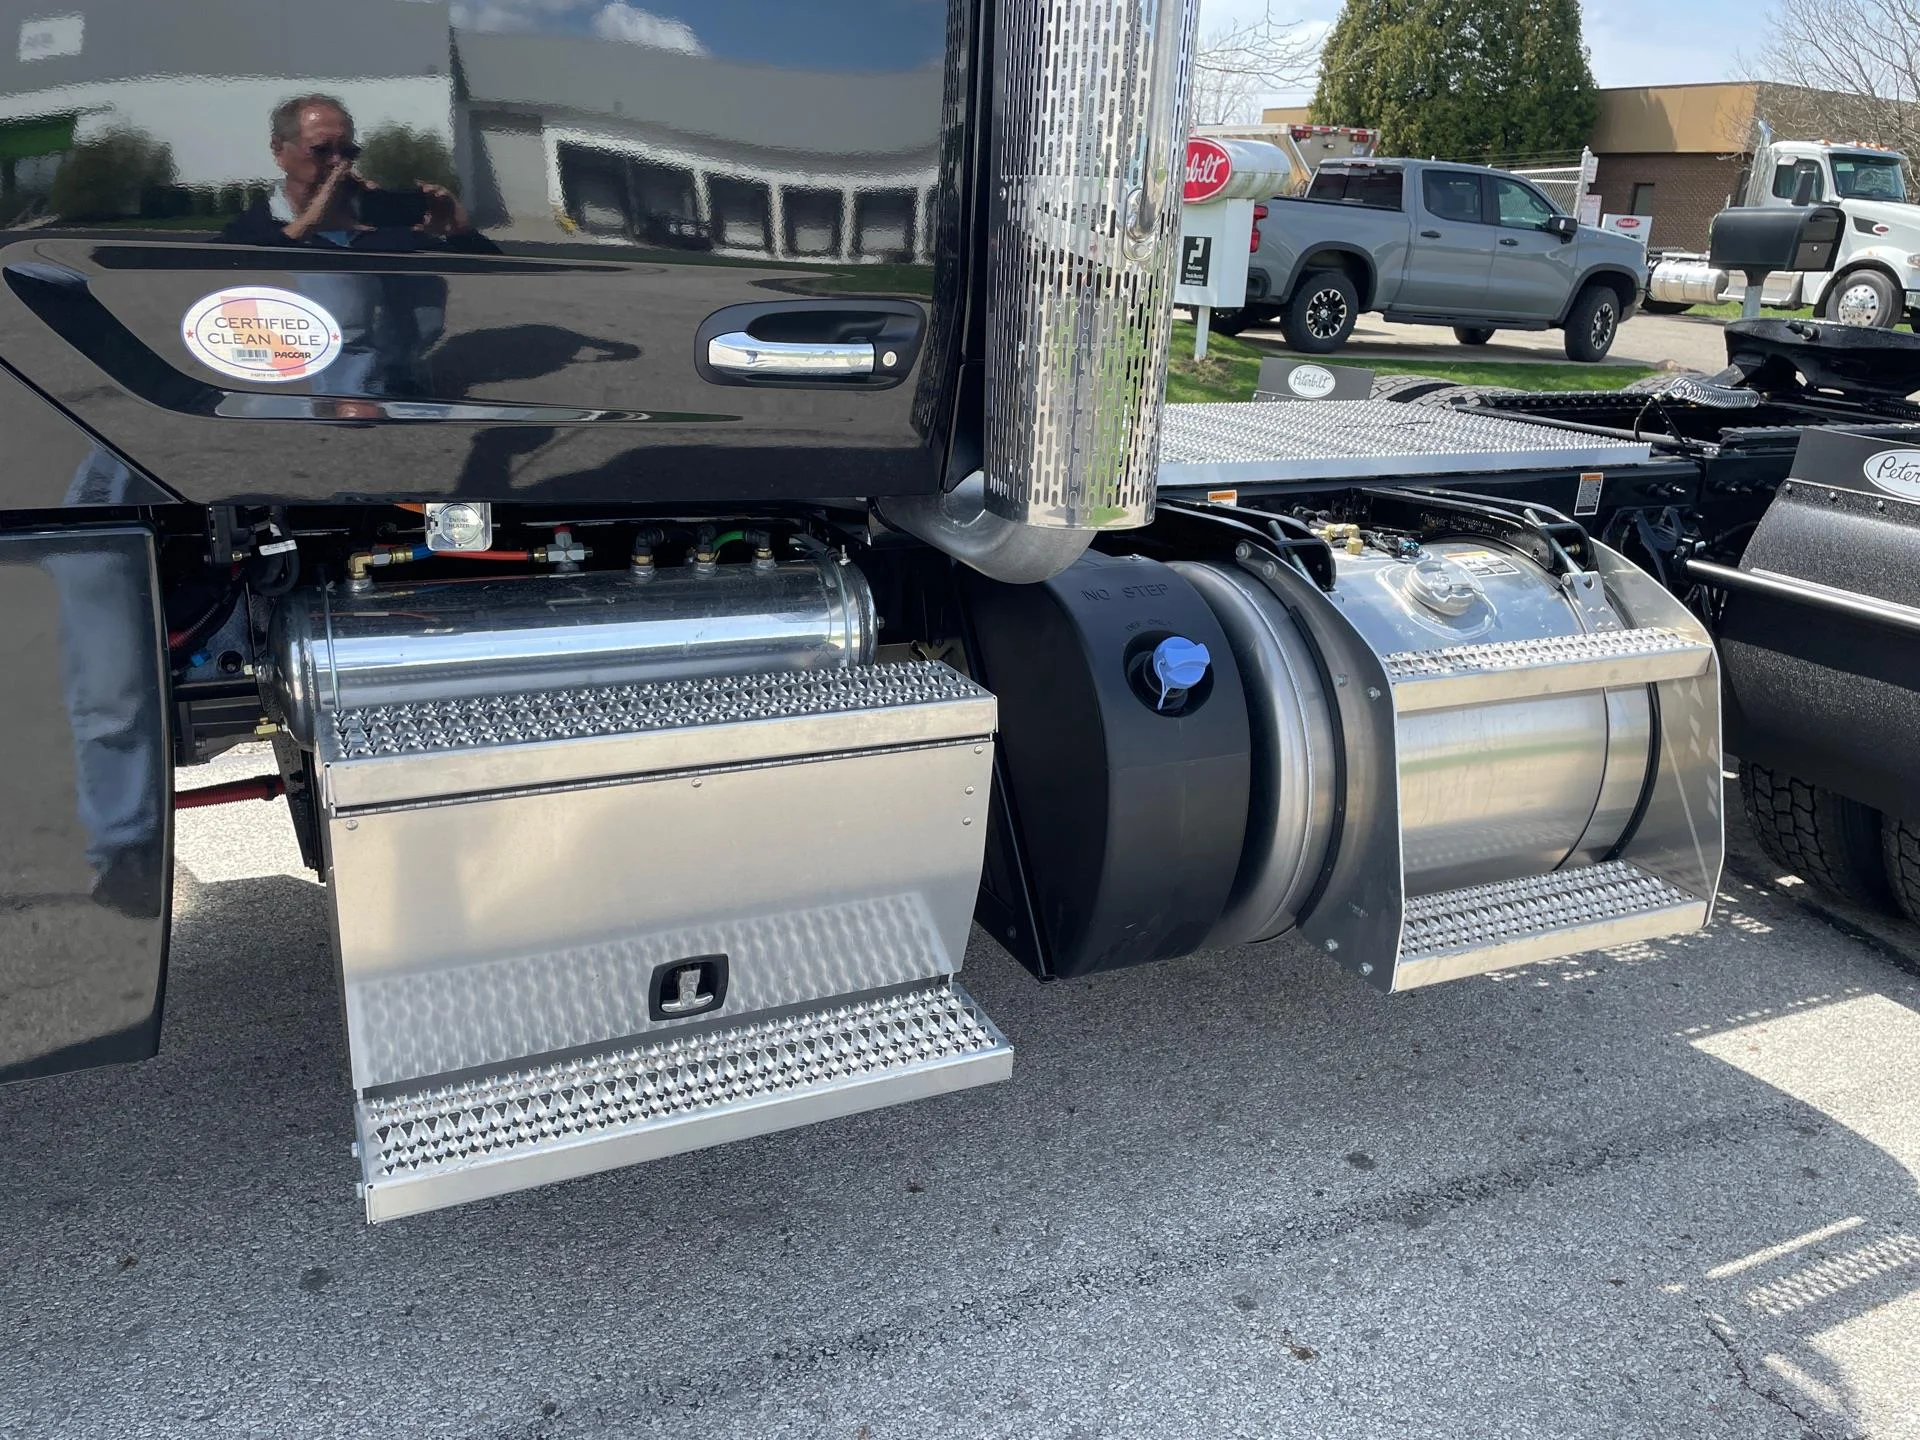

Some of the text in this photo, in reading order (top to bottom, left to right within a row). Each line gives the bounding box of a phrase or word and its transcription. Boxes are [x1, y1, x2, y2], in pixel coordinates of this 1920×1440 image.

[214, 317, 310, 330] CERTIFIED
[207, 333, 321, 347] CLEAN IDLE
[274, 351, 312, 359] PACCAR
[1080, 583, 1169, 601] NO STEP
